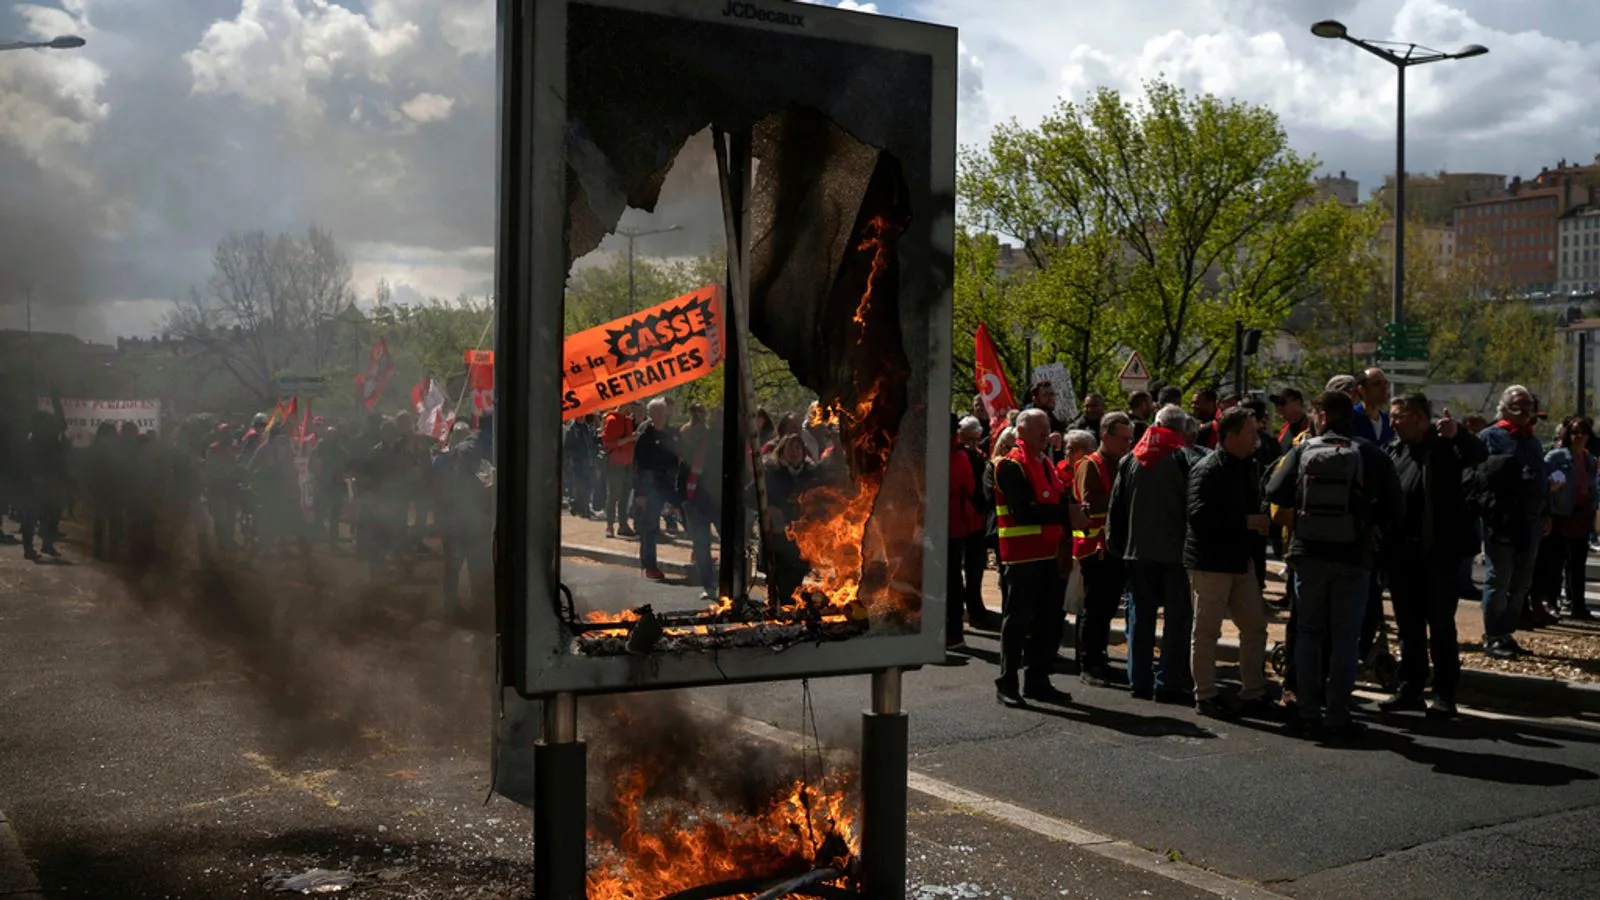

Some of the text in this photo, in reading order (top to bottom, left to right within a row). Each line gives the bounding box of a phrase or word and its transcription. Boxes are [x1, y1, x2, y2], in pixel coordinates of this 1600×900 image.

[722, 0, 804, 27] JCDecaux
[570, 308, 707, 374] à la CASSE
[595, 348, 704, 400] RETRAITES
